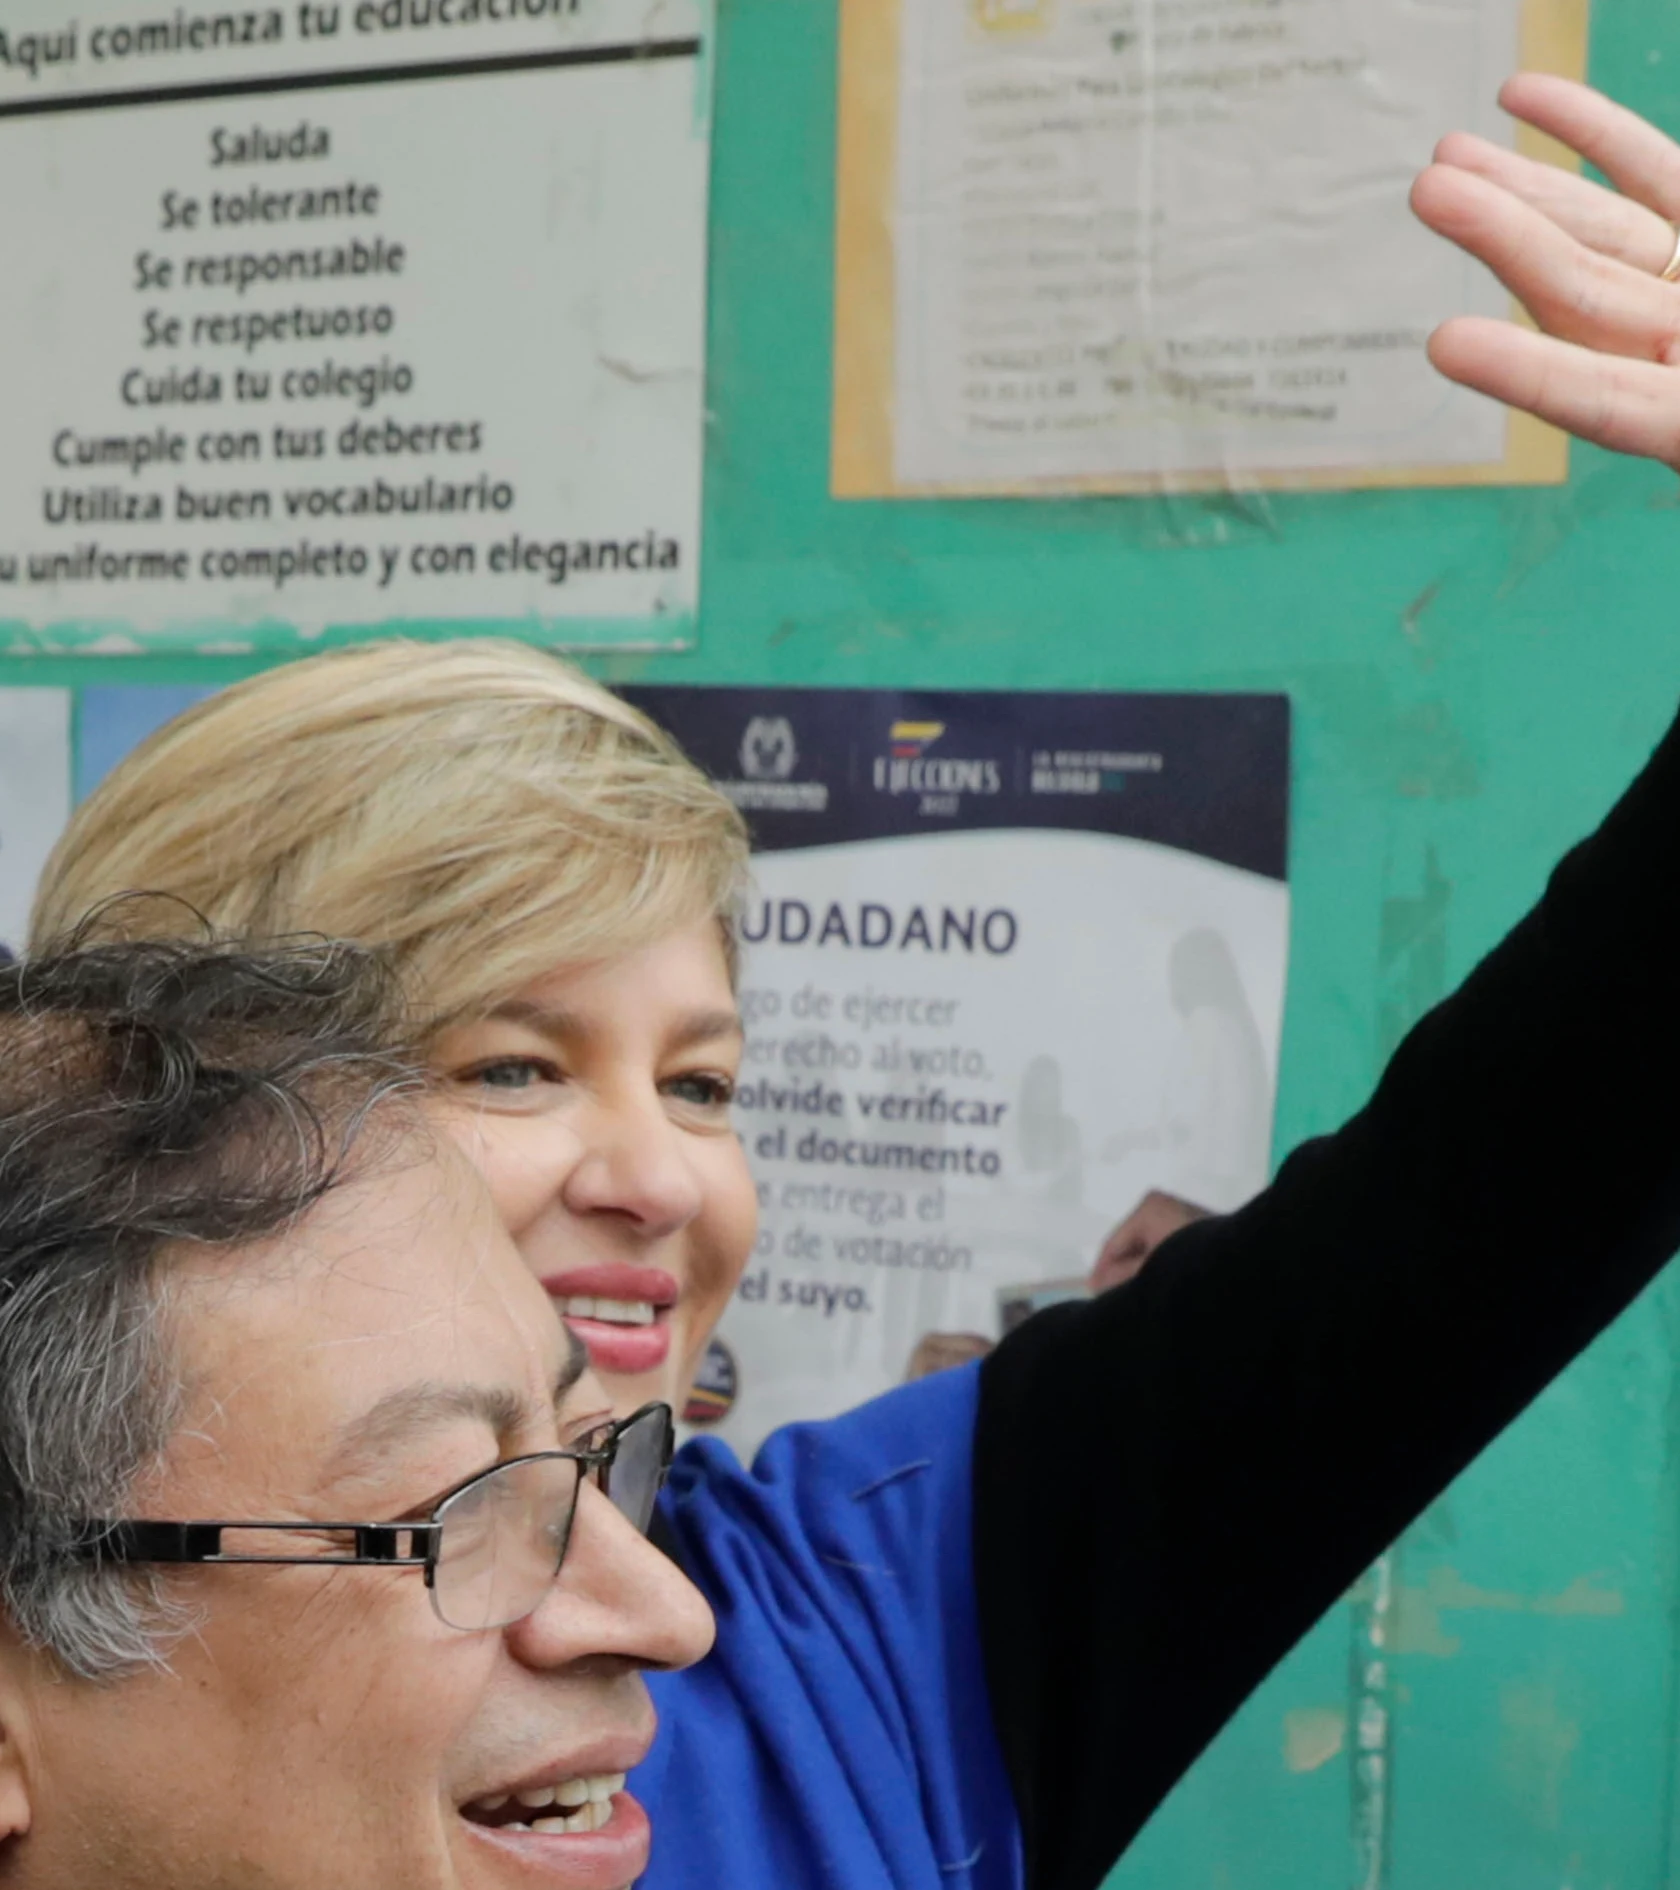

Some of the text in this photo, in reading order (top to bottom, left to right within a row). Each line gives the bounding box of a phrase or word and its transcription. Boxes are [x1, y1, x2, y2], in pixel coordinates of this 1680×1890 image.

[89, 10, 283, 60] comienza
[298, 2, 340, 39] tu
[210, 123, 330, 167] Saluda
[161, 182, 380, 230] Se tolerante
[135, 237, 405, 294] Se responsable
[143, 305, 394, 354] Se respetuoso
[120, 359, 414, 409] Cuida tu colegio
[52, 418, 482, 475] Cumple con tus deberes
[43, 477, 514, 525] Utiliza buen vocabulario
[27, 543, 190, 583] uniforme
[200, 541, 369, 588] completo
[378, 549, 399, 588] y
[409, 544, 476, 575] con
[487, 535, 680, 582] elegancia
[742, 900, 1018, 956] UDADANO
[790, 981, 833, 1021] de
[842, 982, 959, 1031] ejercer
[740, 1031, 862, 1070] erecho
[737, 1079, 1008, 1128] olvide verificar
[754, 1128, 1001, 1177] el documento
[780, 1184, 906, 1226] entrega
[916, 1187, 944, 1221] el
[782, 1227, 824, 1261] de
[833, 1235, 972, 1271] votación
[778, 1280, 870, 1318] suyo.
